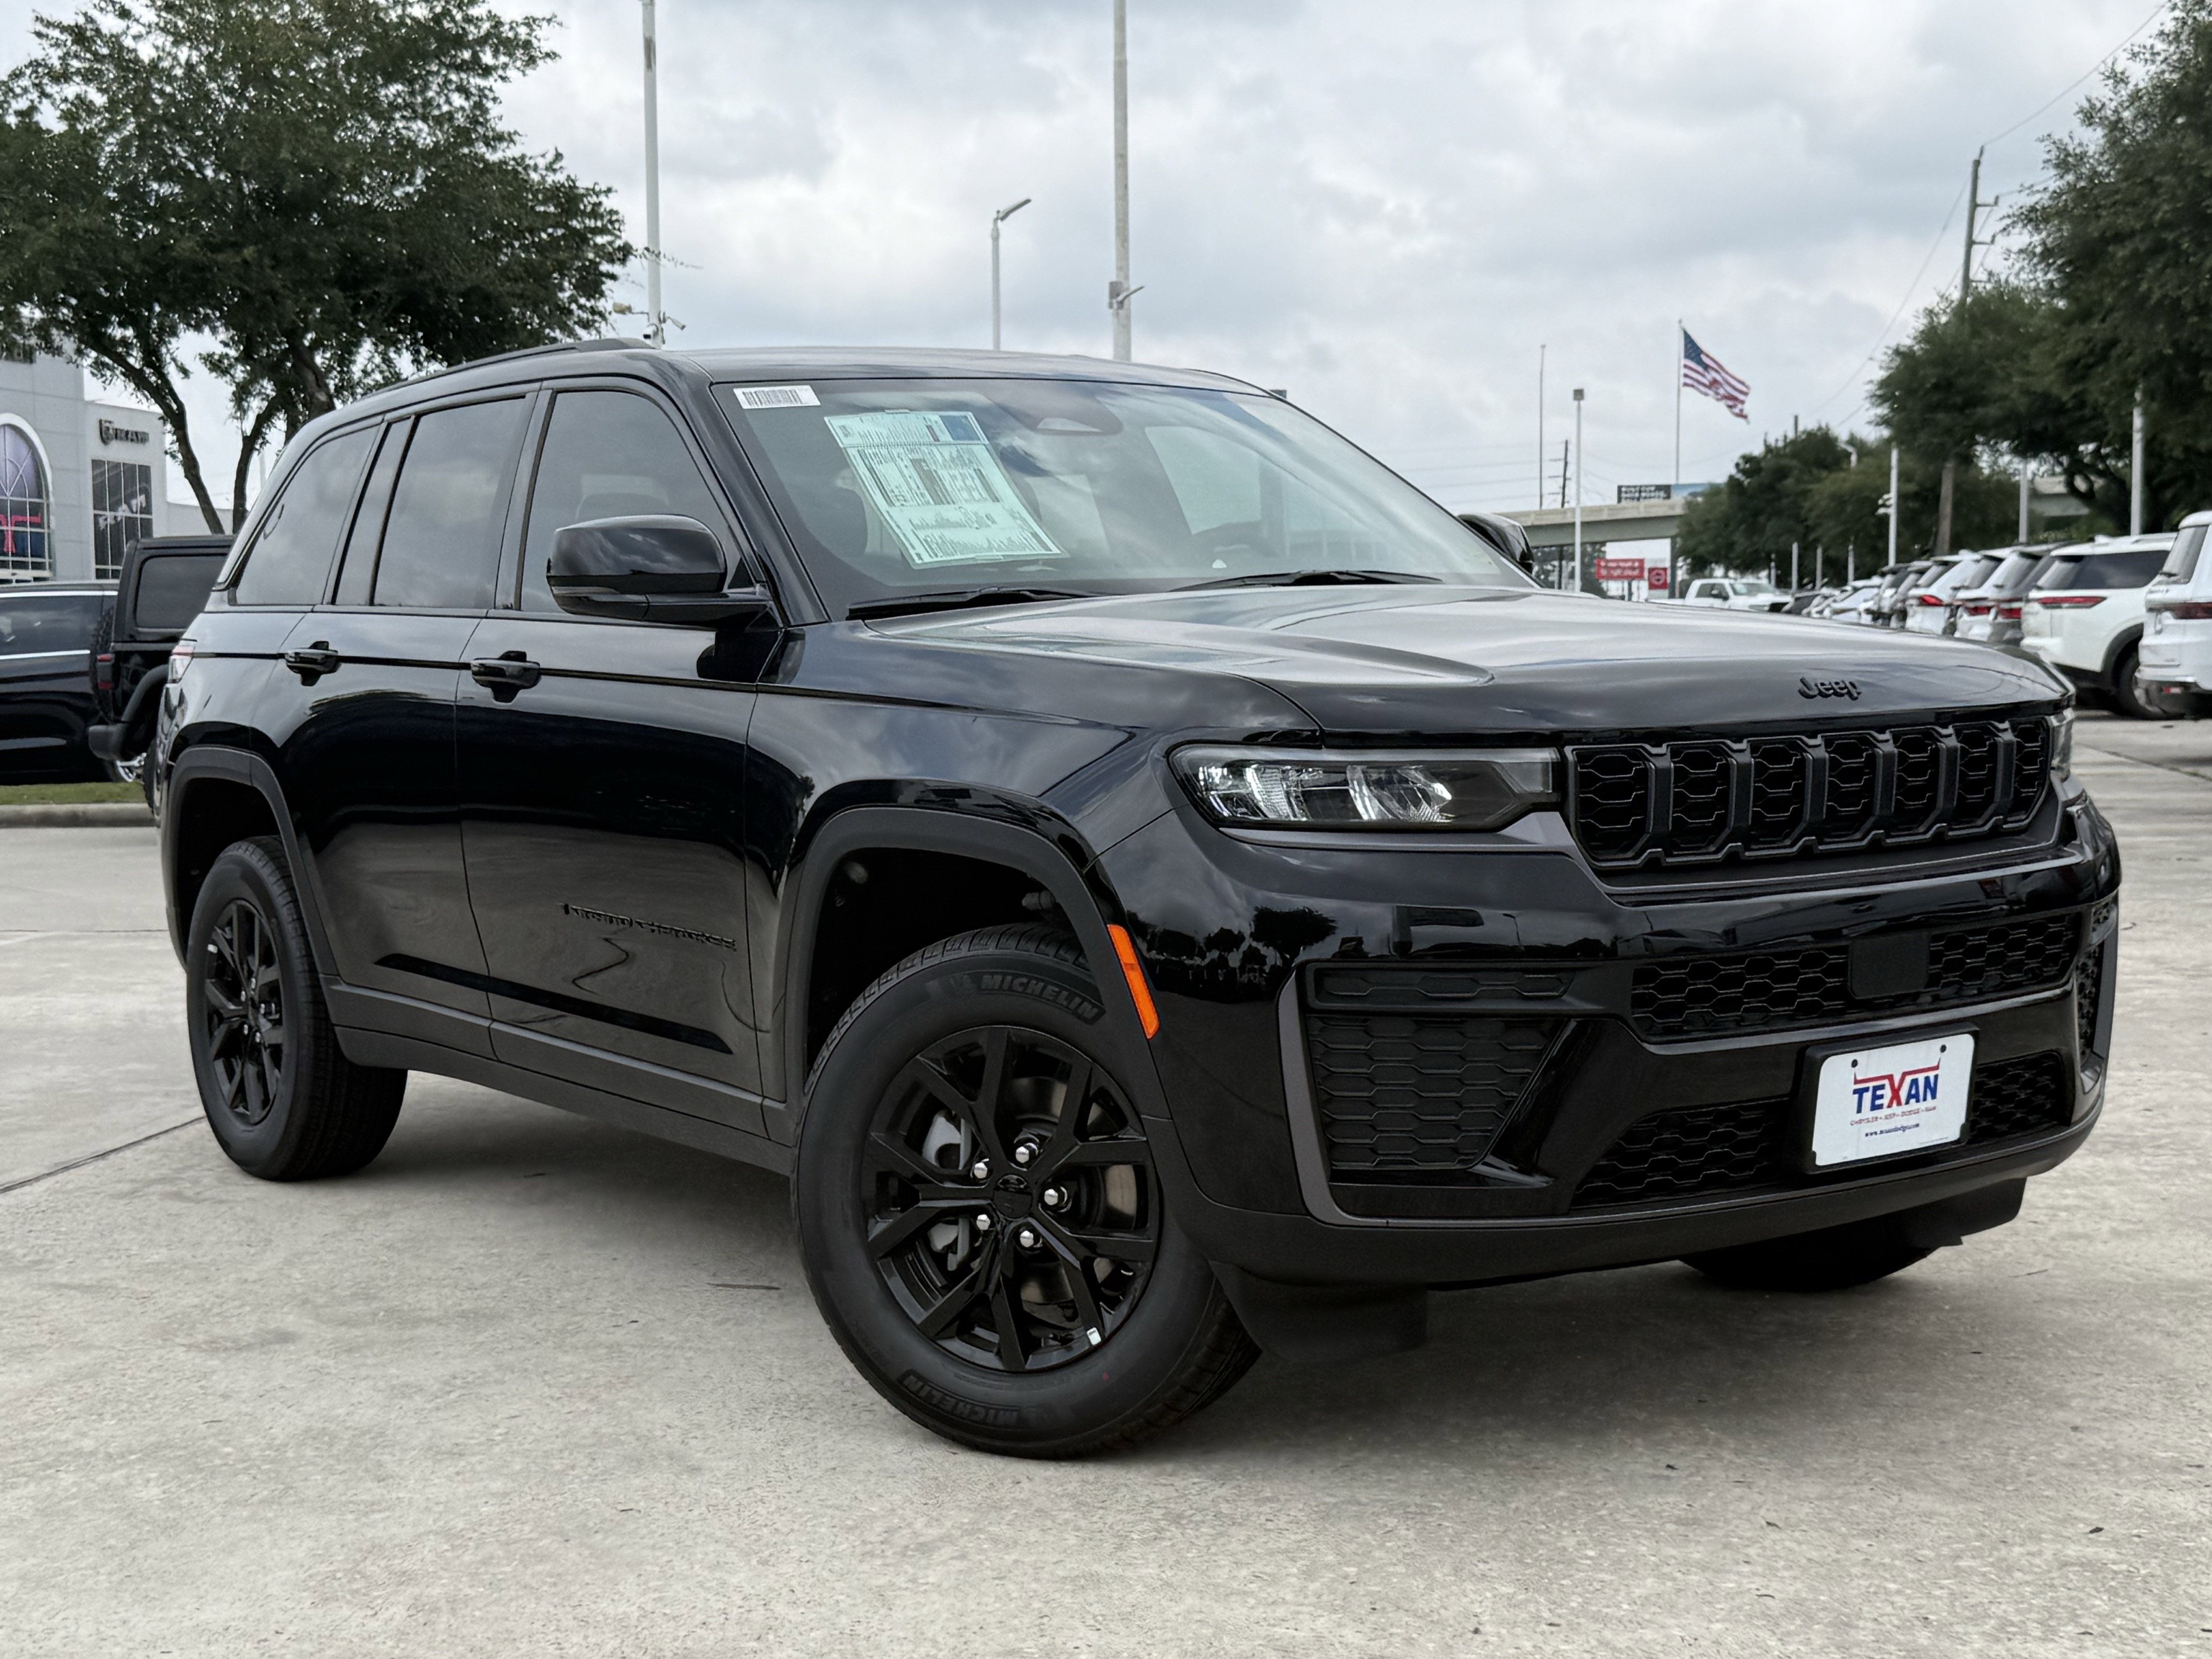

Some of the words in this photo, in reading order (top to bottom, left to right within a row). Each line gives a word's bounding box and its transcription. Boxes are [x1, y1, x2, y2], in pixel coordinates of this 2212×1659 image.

[1798, 677, 1861, 701] Jeep
[980, 974, 1099, 1018] MICHELIN
[1853, 1062, 1940, 1114] TEXAN
